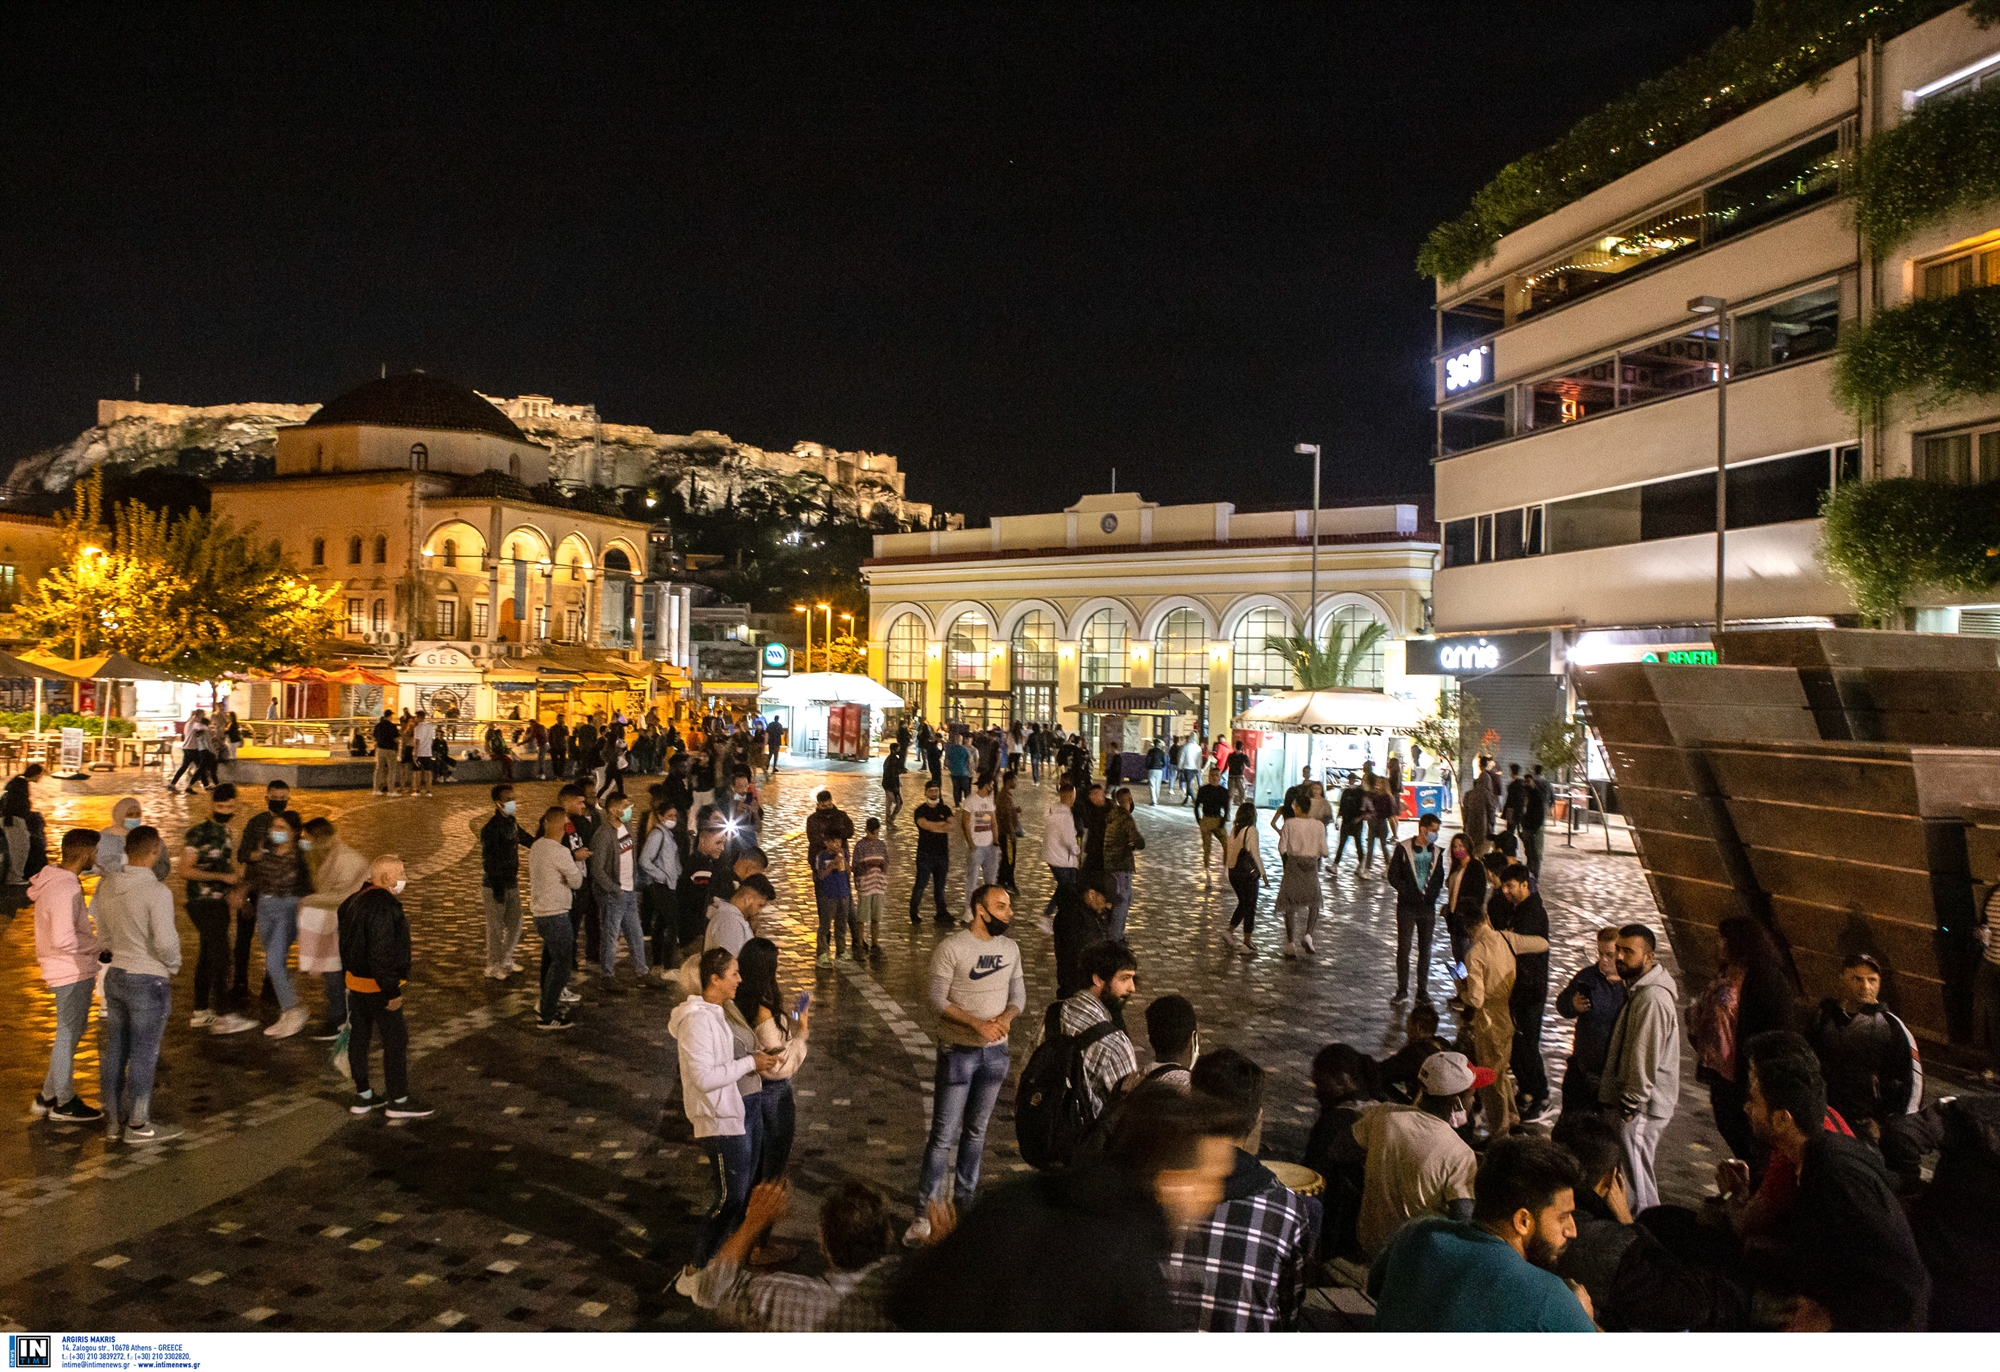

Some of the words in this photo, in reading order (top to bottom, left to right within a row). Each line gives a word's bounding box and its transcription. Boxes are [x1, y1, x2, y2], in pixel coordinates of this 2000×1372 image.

[427, 653, 459, 665] GES
[1440, 638, 1499, 668] annie
[976, 955, 1004, 970] NIKE
